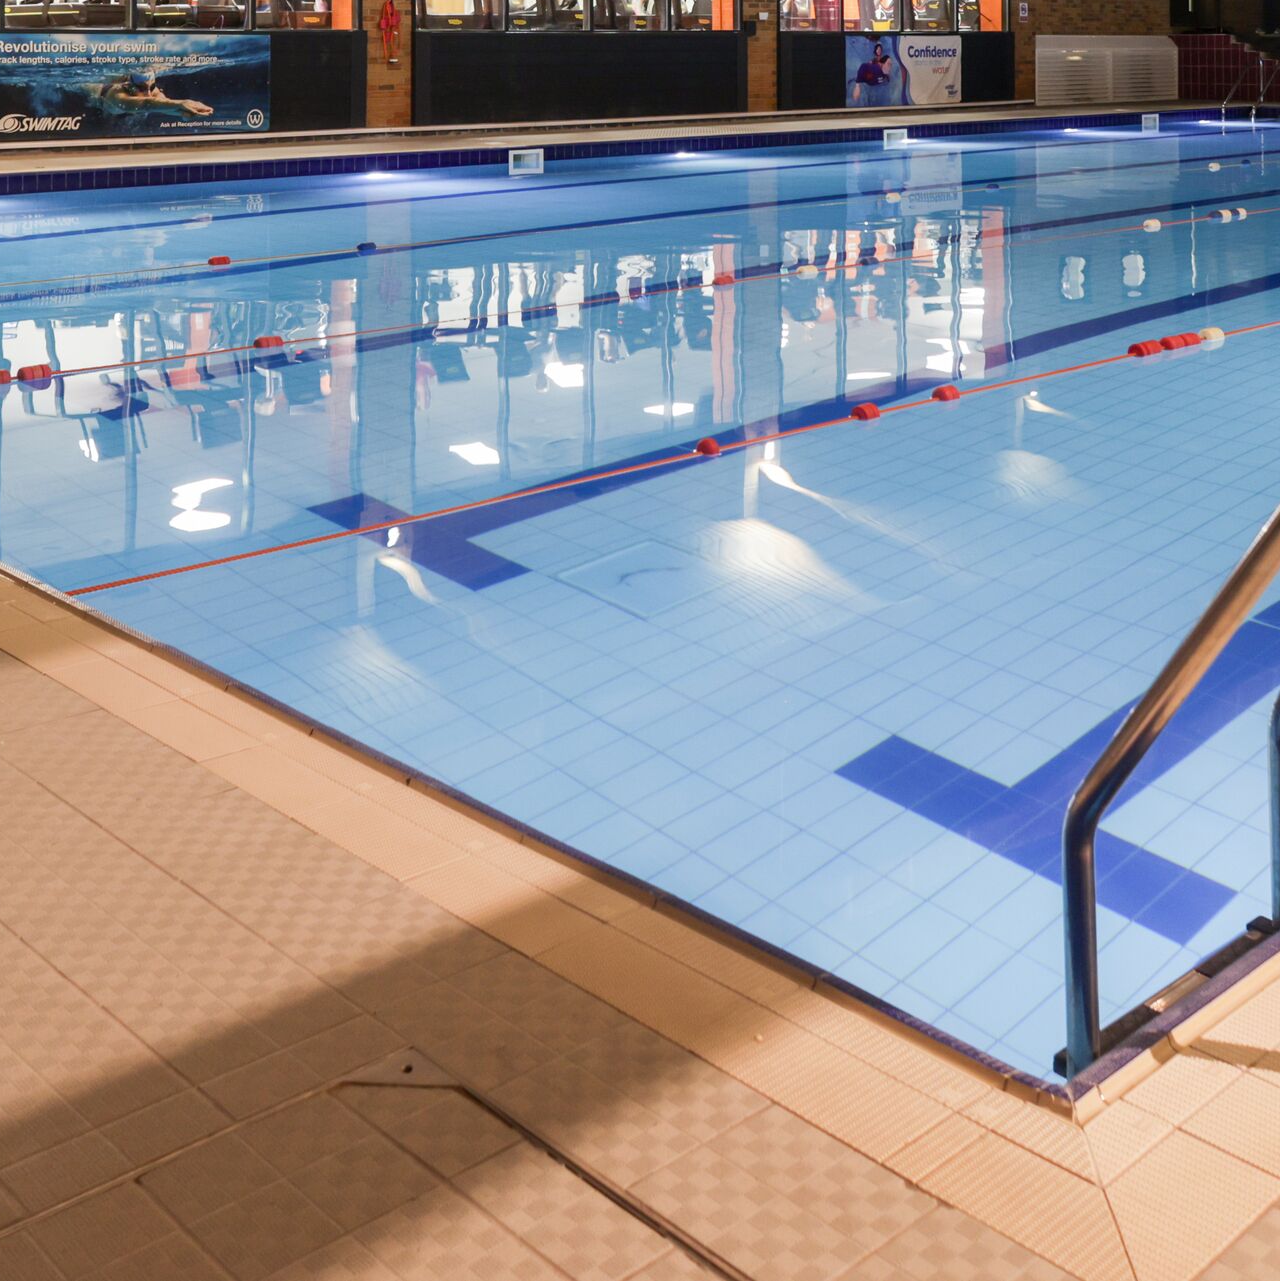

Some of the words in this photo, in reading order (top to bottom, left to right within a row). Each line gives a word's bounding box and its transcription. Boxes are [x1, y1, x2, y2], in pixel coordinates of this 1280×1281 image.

[91, 43, 120, 56] your
[123, 41, 157, 53] swim
[907, 45, 957, 58] Confidence
[19, 56, 52, 65] lengths,
[55, 56, 89, 65] calories,
[91, 56, 116, 64] stroke
[118, 56, 138, 64] type,
[183, 55, 197, 63] and
[20, 116, 82, 132] SWIMTAG
